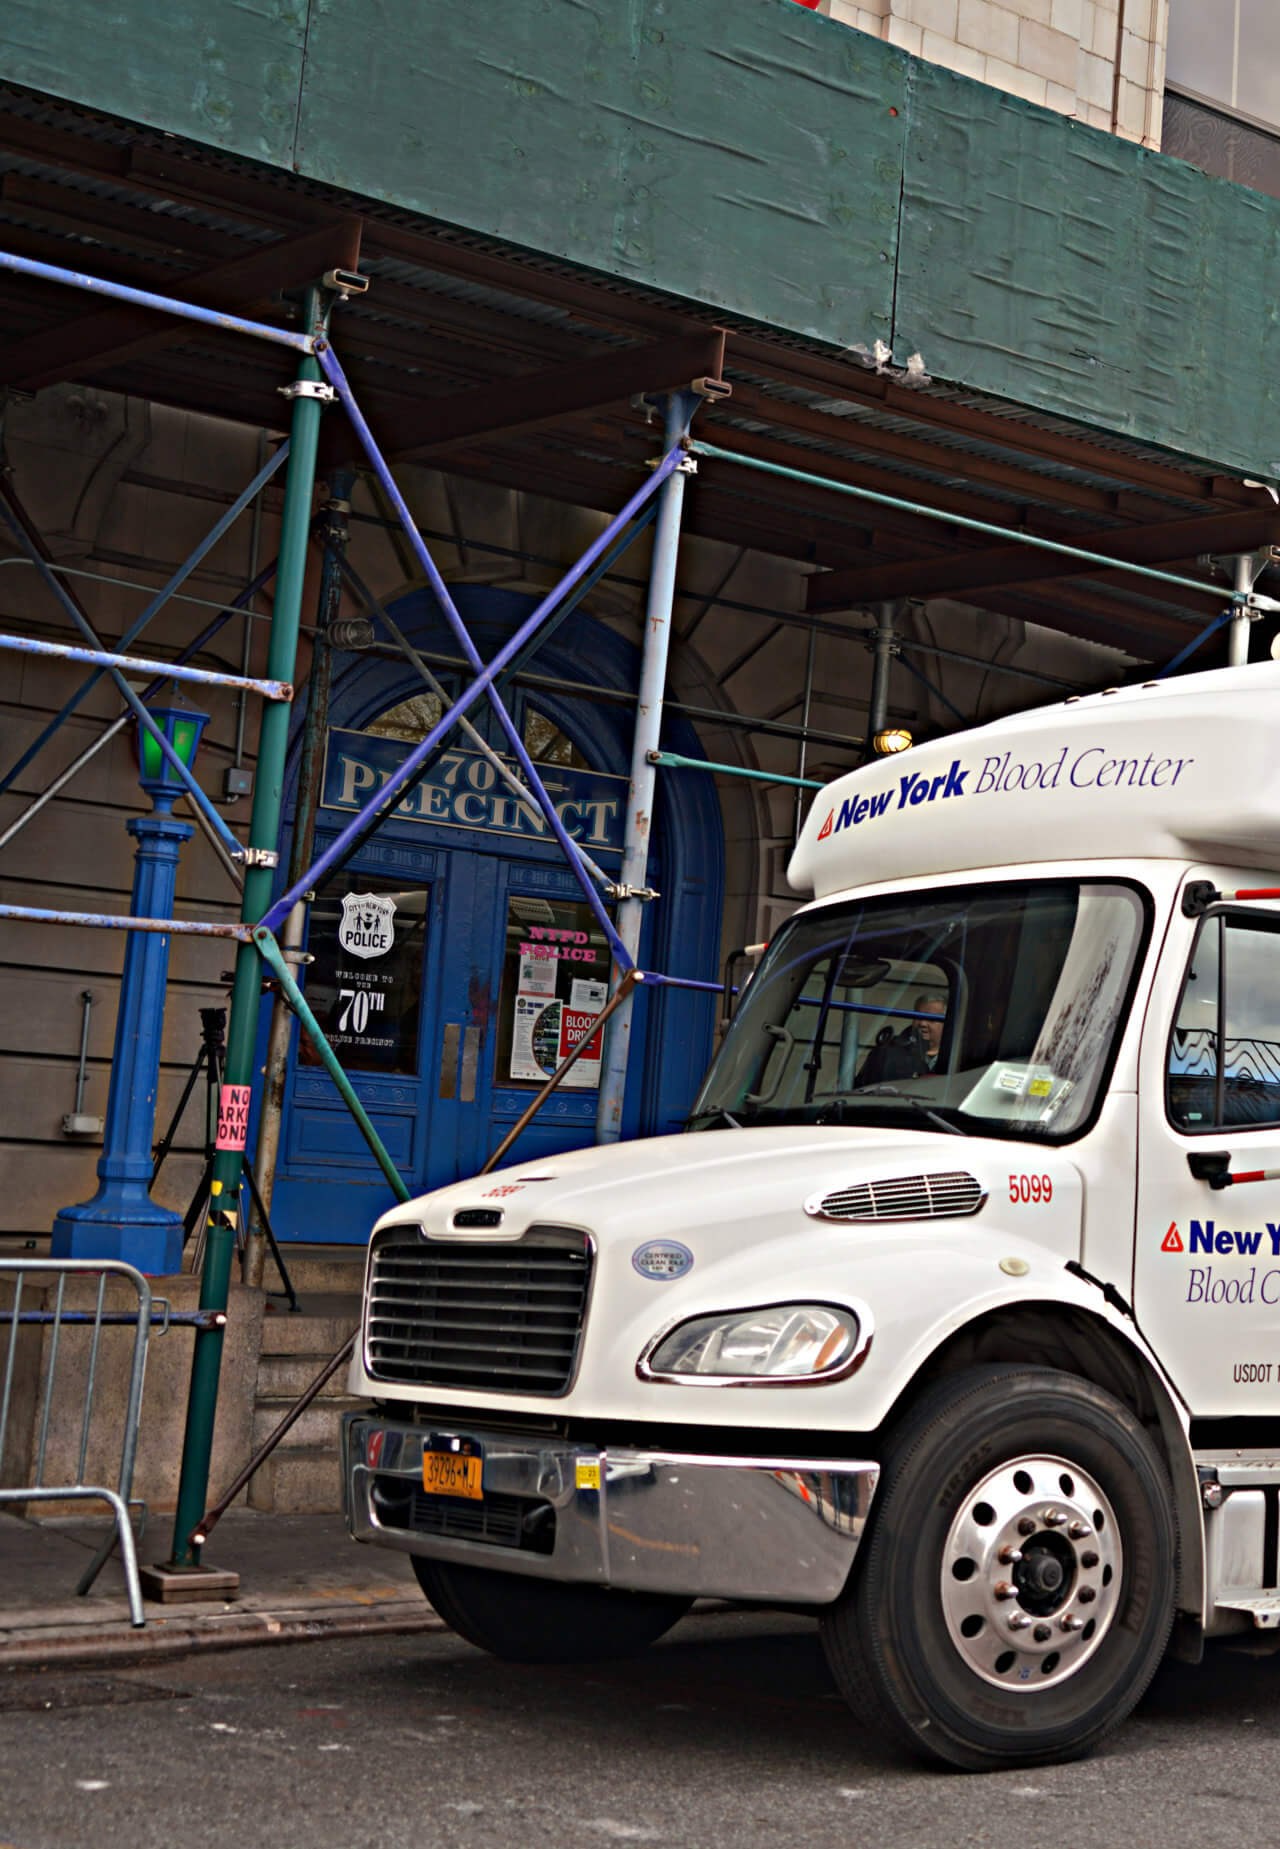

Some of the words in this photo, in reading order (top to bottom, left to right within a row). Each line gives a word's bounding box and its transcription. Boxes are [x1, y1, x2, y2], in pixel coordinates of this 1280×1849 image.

[834, 791, 895, 832] New
[897, 759, 970, 810] York
[973, 747, 1069, 794] Blood
[1069, 747, 1194, 788] Center
[345, 931, 387, 949] POLICE
[529, 926, 588, 944] NYPD
[518, 942, 596, 962] POLICE
[335, 970, 378, 982] WELCOME
[382, 975, 394, 983] TO
[339, 989, 385, 1033] 70TH
[566, 1015, 597, 1029] BLOO
[231, 1089, 249, 1105] NO
[1008, 1174, 1053, 1203] 5099
[1189, 1220, 1263, 1255] New
[1185, 1266, 1256, 1304] Blood
[1233, 1364, 1273, 1383] USDOT
